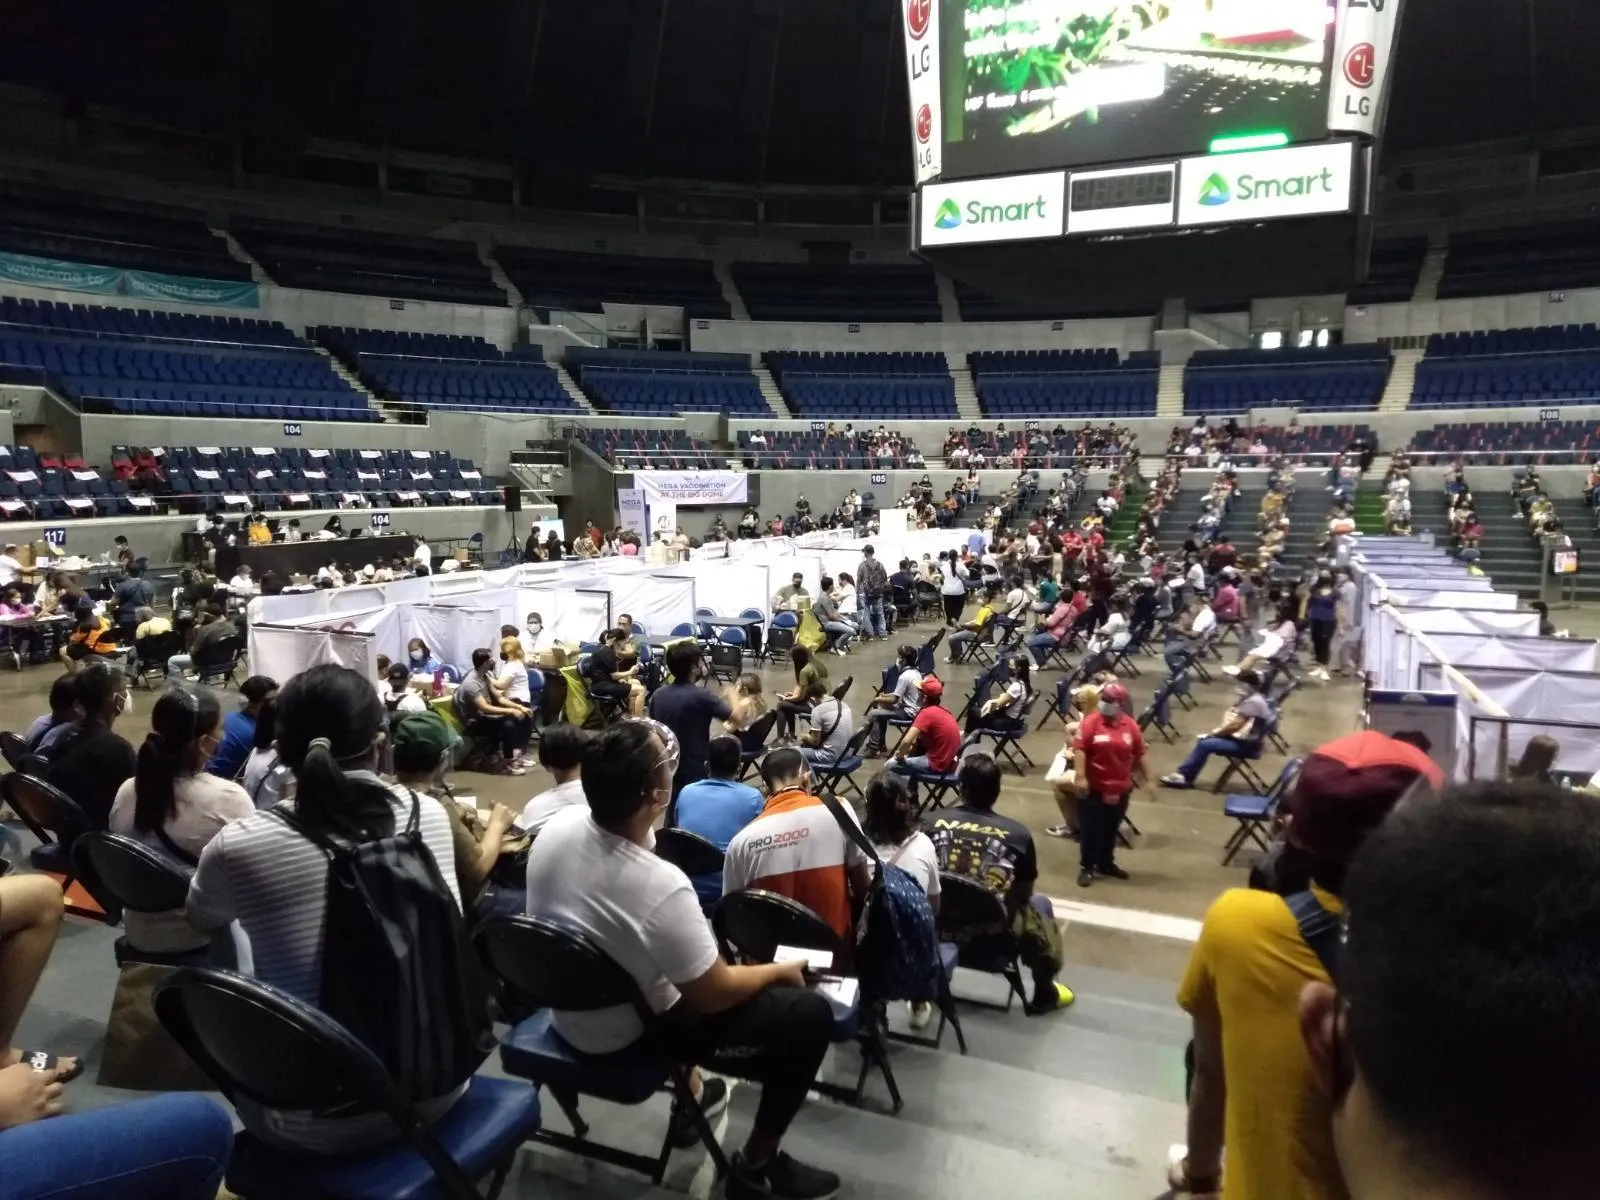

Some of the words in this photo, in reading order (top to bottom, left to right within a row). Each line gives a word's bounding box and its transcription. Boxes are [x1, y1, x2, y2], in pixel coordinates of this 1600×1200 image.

[911, 44, 930, 80] LG
[1344, 95, 1370, 116] LG
[919, 148, 932, 168] LG
[1236, 162, 1333, 201] Smart
[965, 194, 1047, 225] Smart
[284, 425, 301, 434] 104
[871, 474, 886, 483] 105
[372, 515, 389, 524] 104
[44, 530, 65, 542] 117
[748, 835, 773, 853] PRO
[773, 827, 810, 844] 2000
